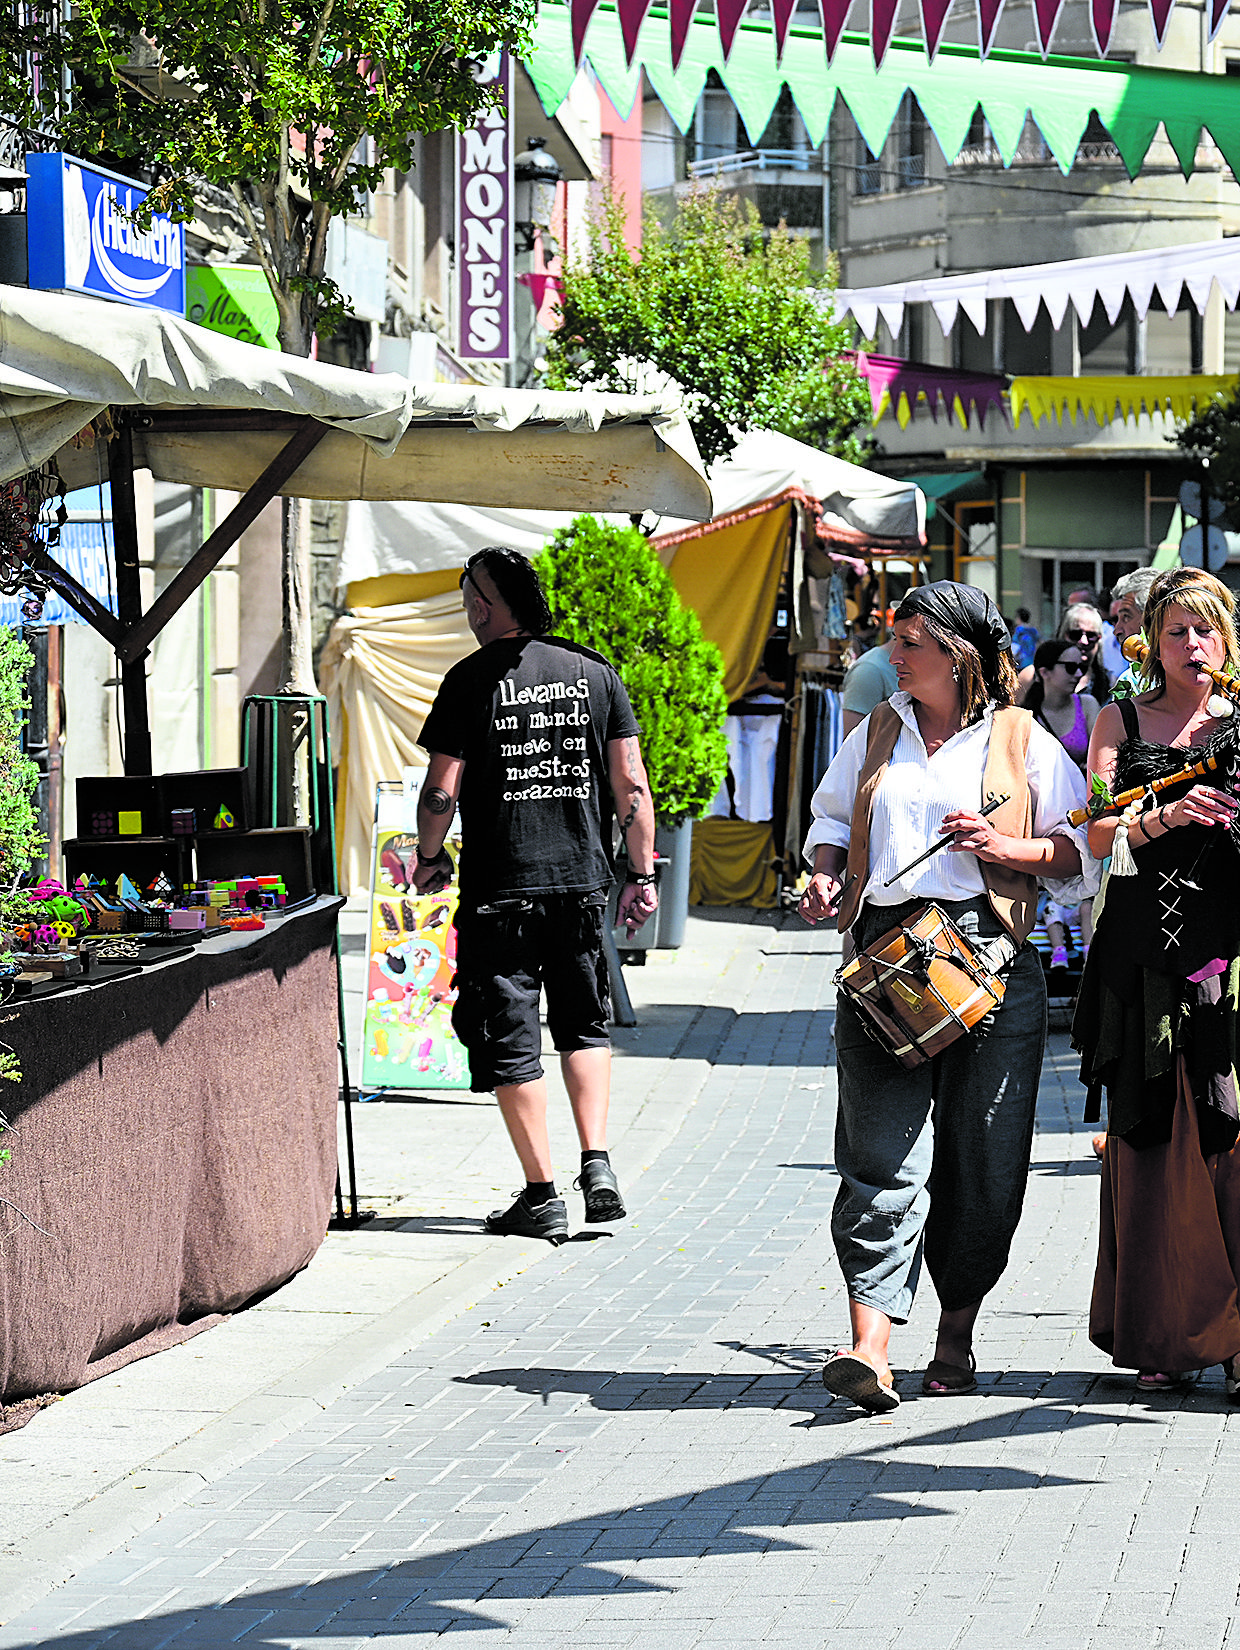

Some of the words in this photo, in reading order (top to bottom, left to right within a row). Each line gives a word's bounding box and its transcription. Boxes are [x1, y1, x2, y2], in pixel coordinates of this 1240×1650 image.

[498, 678, 590, 707] llevamos
[494, 715, 518, 731] un
[529, 700, 590, 729] mundo
[500, 737, 552, 757] nuevo
[562, 736, 586, 751] en
[505, 755, 591, 781] nuestros
[502, 781, 591, 801] corazones
